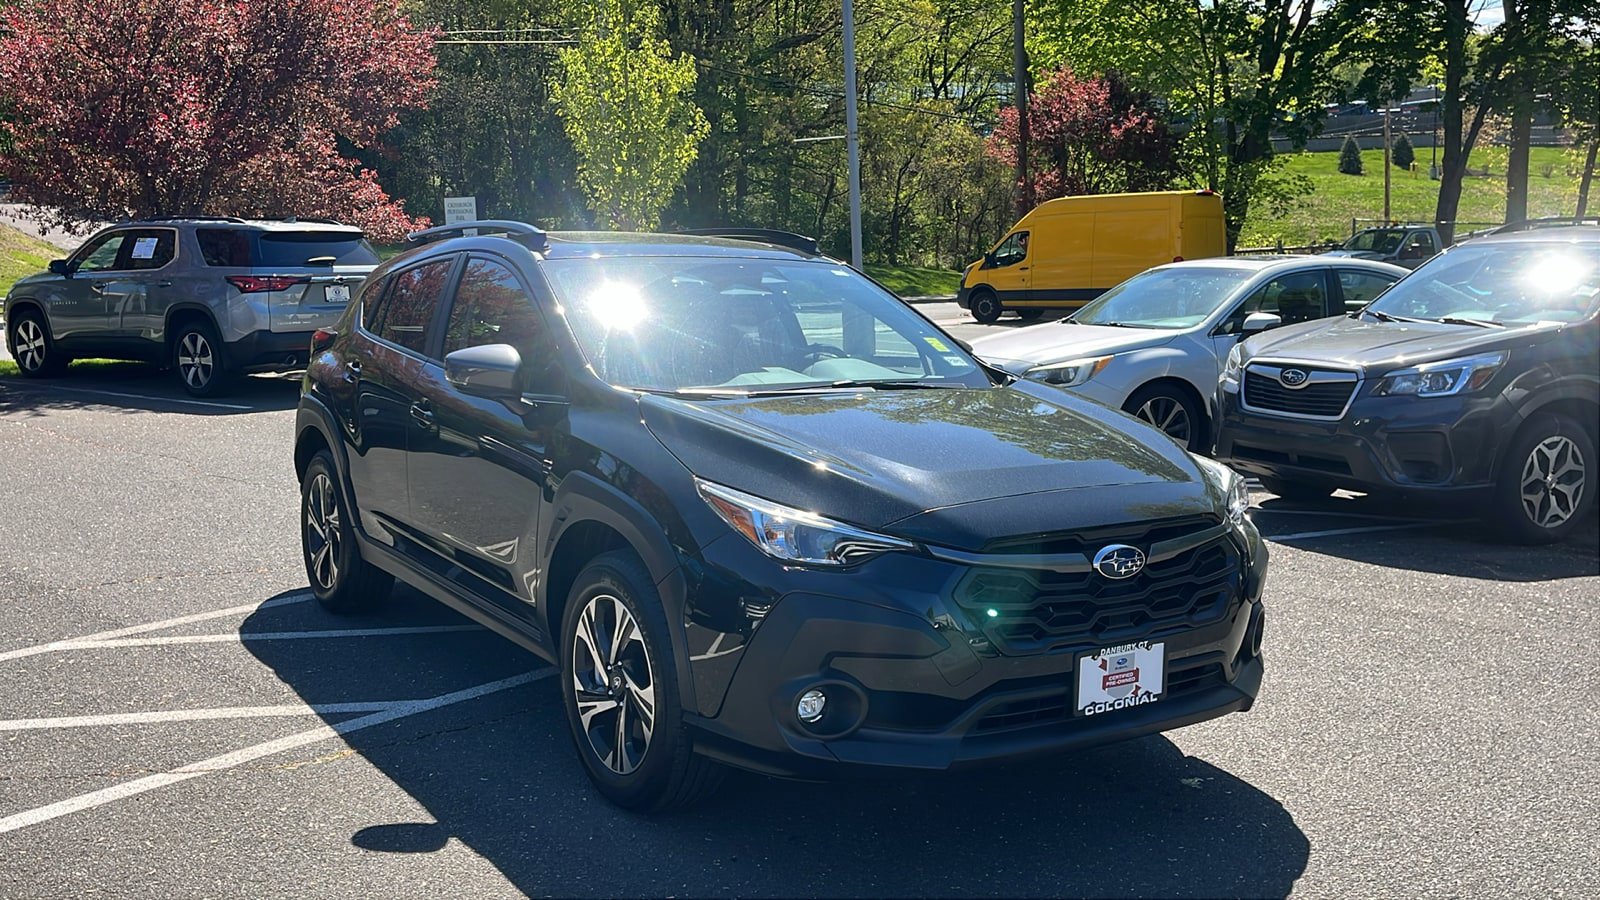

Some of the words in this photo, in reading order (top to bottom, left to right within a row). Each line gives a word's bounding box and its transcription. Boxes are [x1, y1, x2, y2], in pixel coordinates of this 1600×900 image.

[1101, 643, 1136, 656] DANBURY
[1106, 676, 1136, 686] PRE-OWNED
[1108, 672, 1134, 681] CERTIFIED
[1085, 694, 1158, 716] COLONIAL
